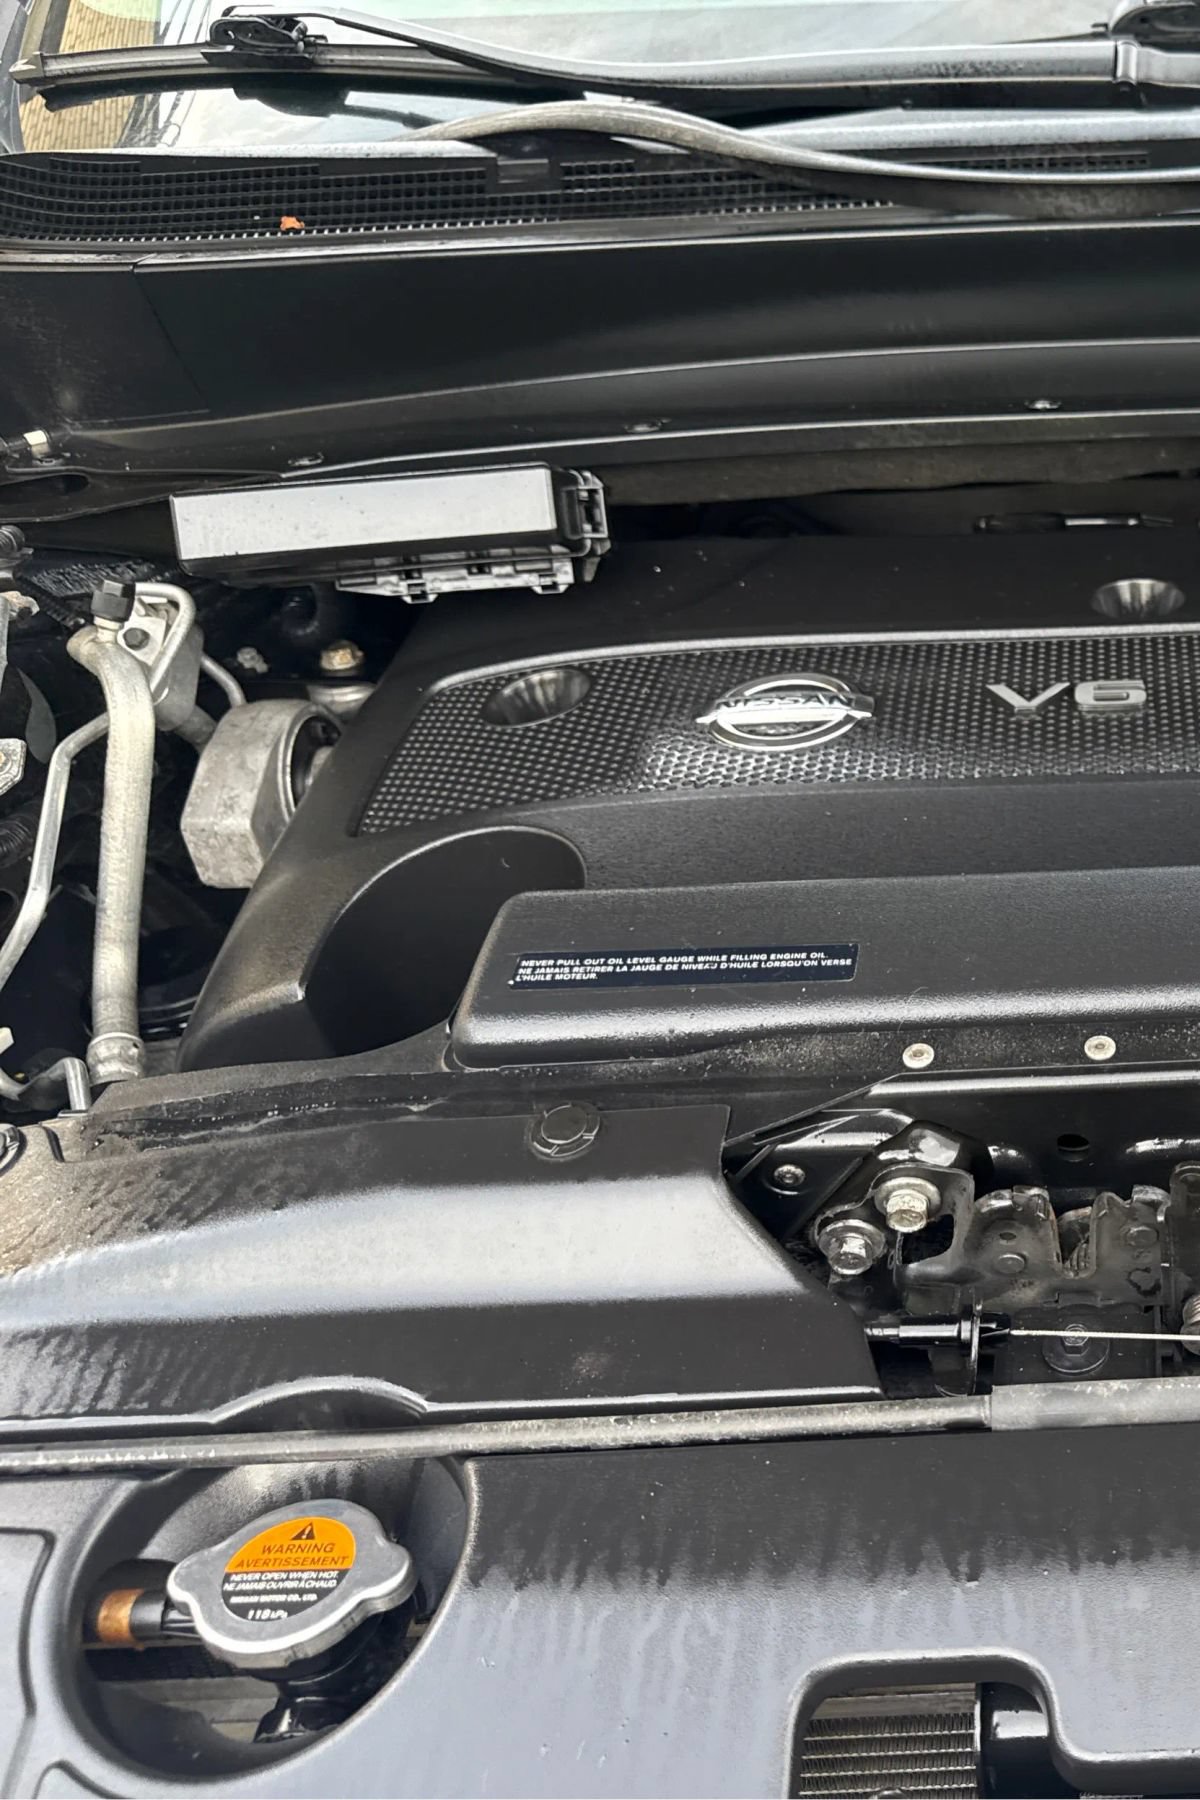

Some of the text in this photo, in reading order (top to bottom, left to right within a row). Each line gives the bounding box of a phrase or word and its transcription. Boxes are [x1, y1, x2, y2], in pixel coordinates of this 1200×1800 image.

[985, 680, 1148, 716] V6
[762, 960, 818, 968] LORSQU'ON
[262, 1543, 335, 1554] WARNING
[235, 1556, 349, 1568] AVERTISSEMENT
[230, 1572, 260, 1582] NEVER
[262, 1572, 286, 1580] OPEN
[289, 1571, 318, 1580] WHEN
[223, 1582, 236, 1591] NE
[236, 1581, 265, 1590] JAMAIS
[266, 1581, 297, 1589] OUVRIR
[304, 1580, 337, 1588] CHAUD.
